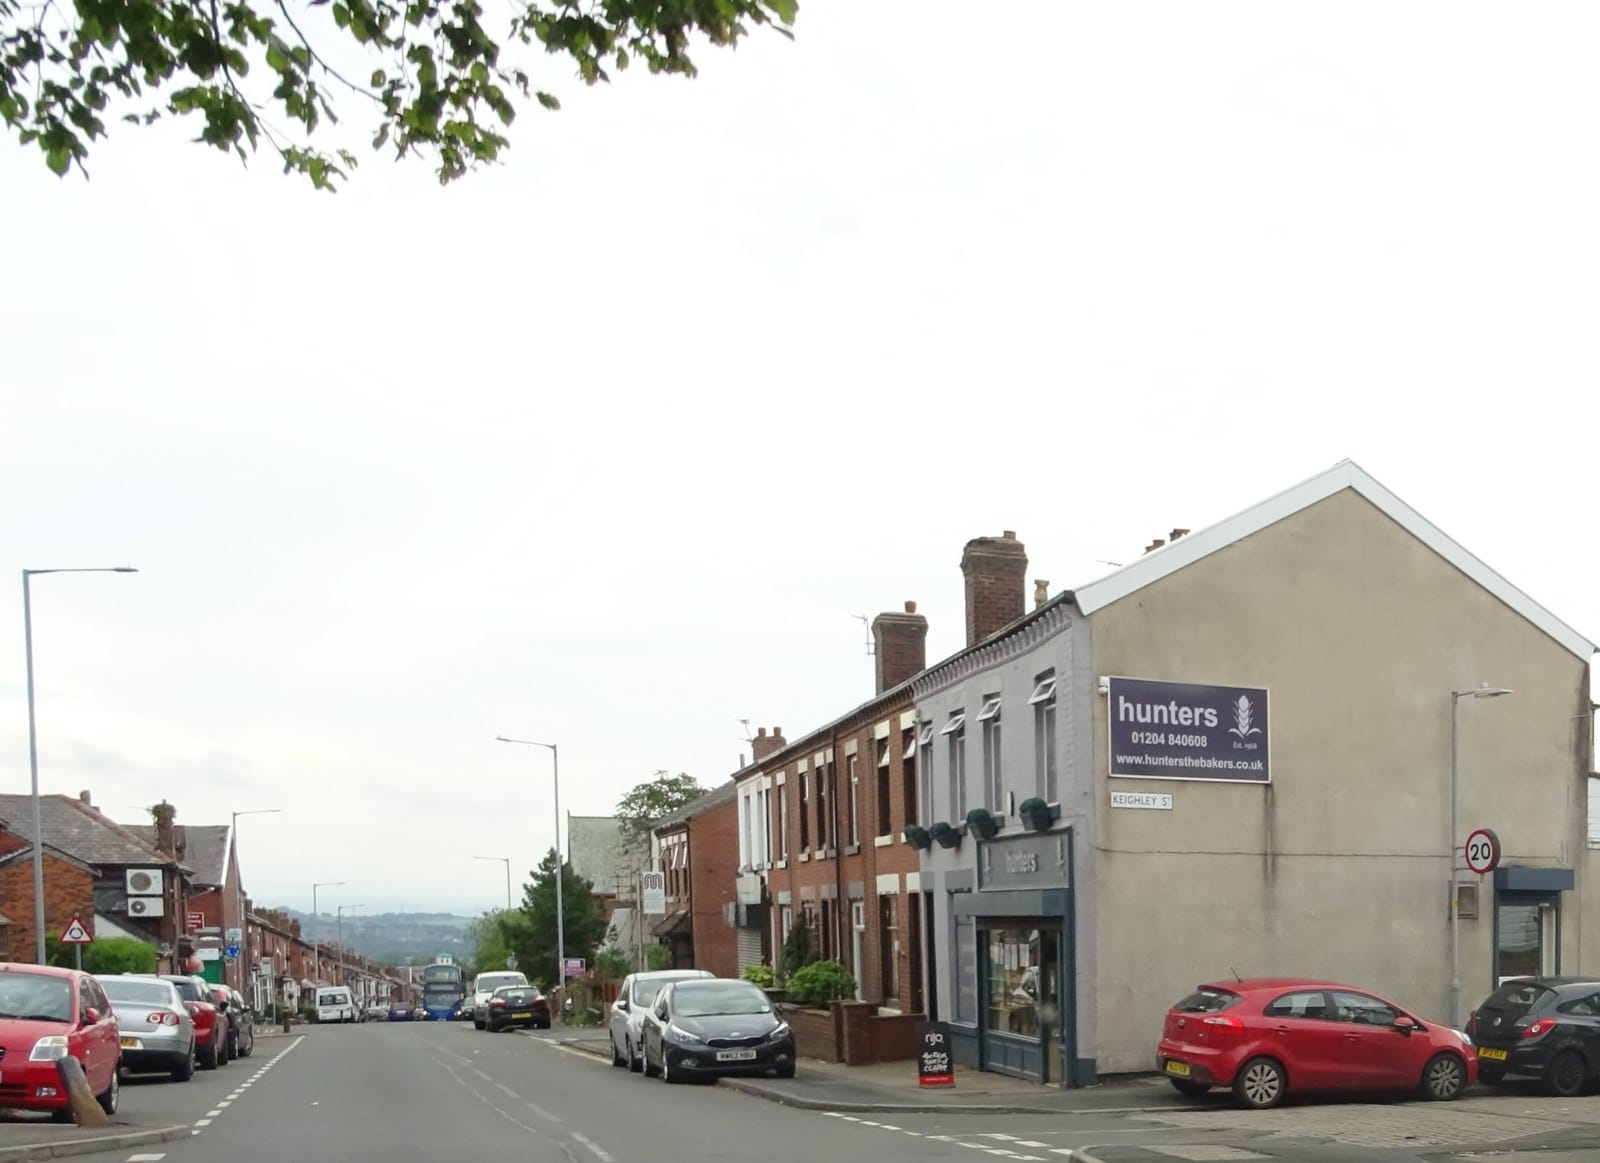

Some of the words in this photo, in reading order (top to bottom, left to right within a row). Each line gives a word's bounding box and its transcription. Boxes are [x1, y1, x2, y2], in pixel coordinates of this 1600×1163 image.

[1118, 695, 1219, 728] hunters
[1131, 731, 1166, 746] 01204
[1167, 733, 1208, 748] 840608
[1116, 753, 1264, 771] www.huntersthebakers.co.uk
[1112, 794, 1157, 806] KEIGHLEY
[1470, 842, 1491, 861] 20
[1006, 849, 1037, 873] hunters
